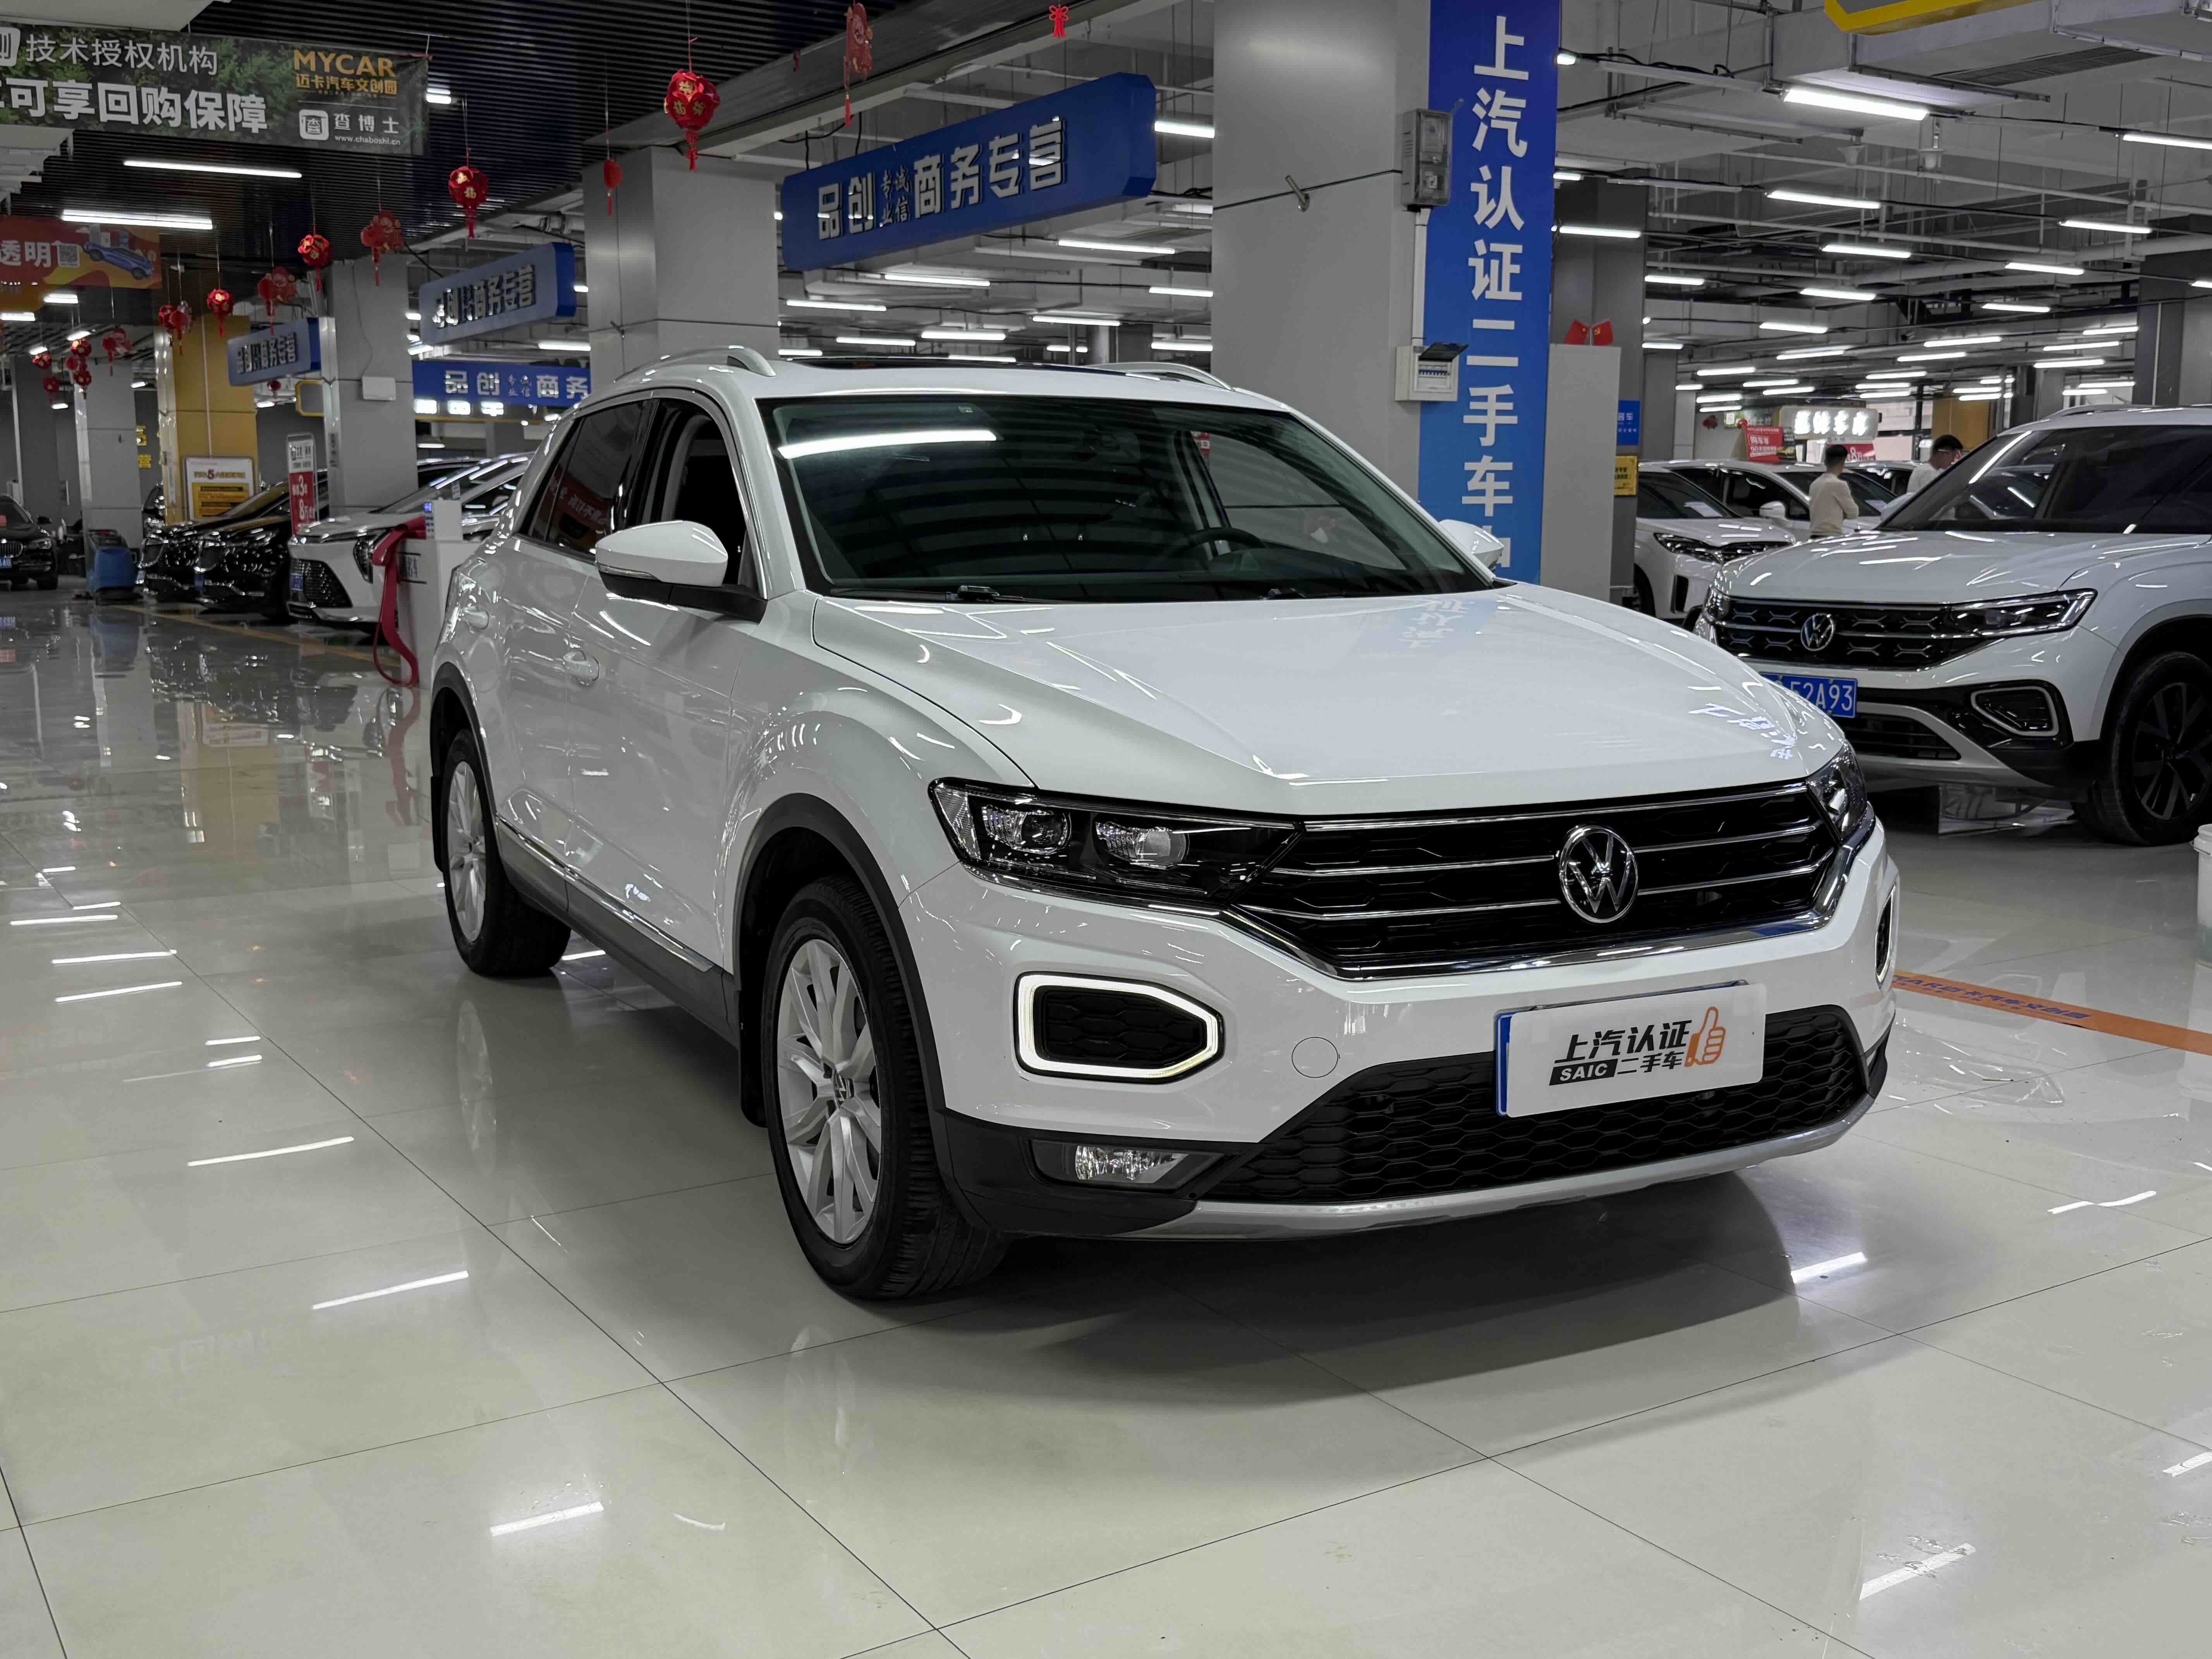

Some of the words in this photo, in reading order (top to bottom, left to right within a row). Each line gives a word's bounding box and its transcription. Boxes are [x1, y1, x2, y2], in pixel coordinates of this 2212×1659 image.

[26, 34, 217, 76] 技术授权机构
[294, 49, 396, 77] MYCAR
[295, 73, 397, 95] 迈卡汽车文创园
[0, 77, 268, 134] 可享回购保障
[333, 113, 399, 134] 查博士
[335, 136, 401, 146] www.chaboshi.cn
[818, 173, 874, 240] 品创
[914, 117, 1062, 218] 商务专营
[0, 240, 51, 268] 透明
[1774, 680, 1853, 711] 2A93
[1554, 1020, 1692, 1063] 上汽认证
[1559, 1063, 1608, 1082] SAIC
[1617, 1051, 1684, 1075] 二手车
